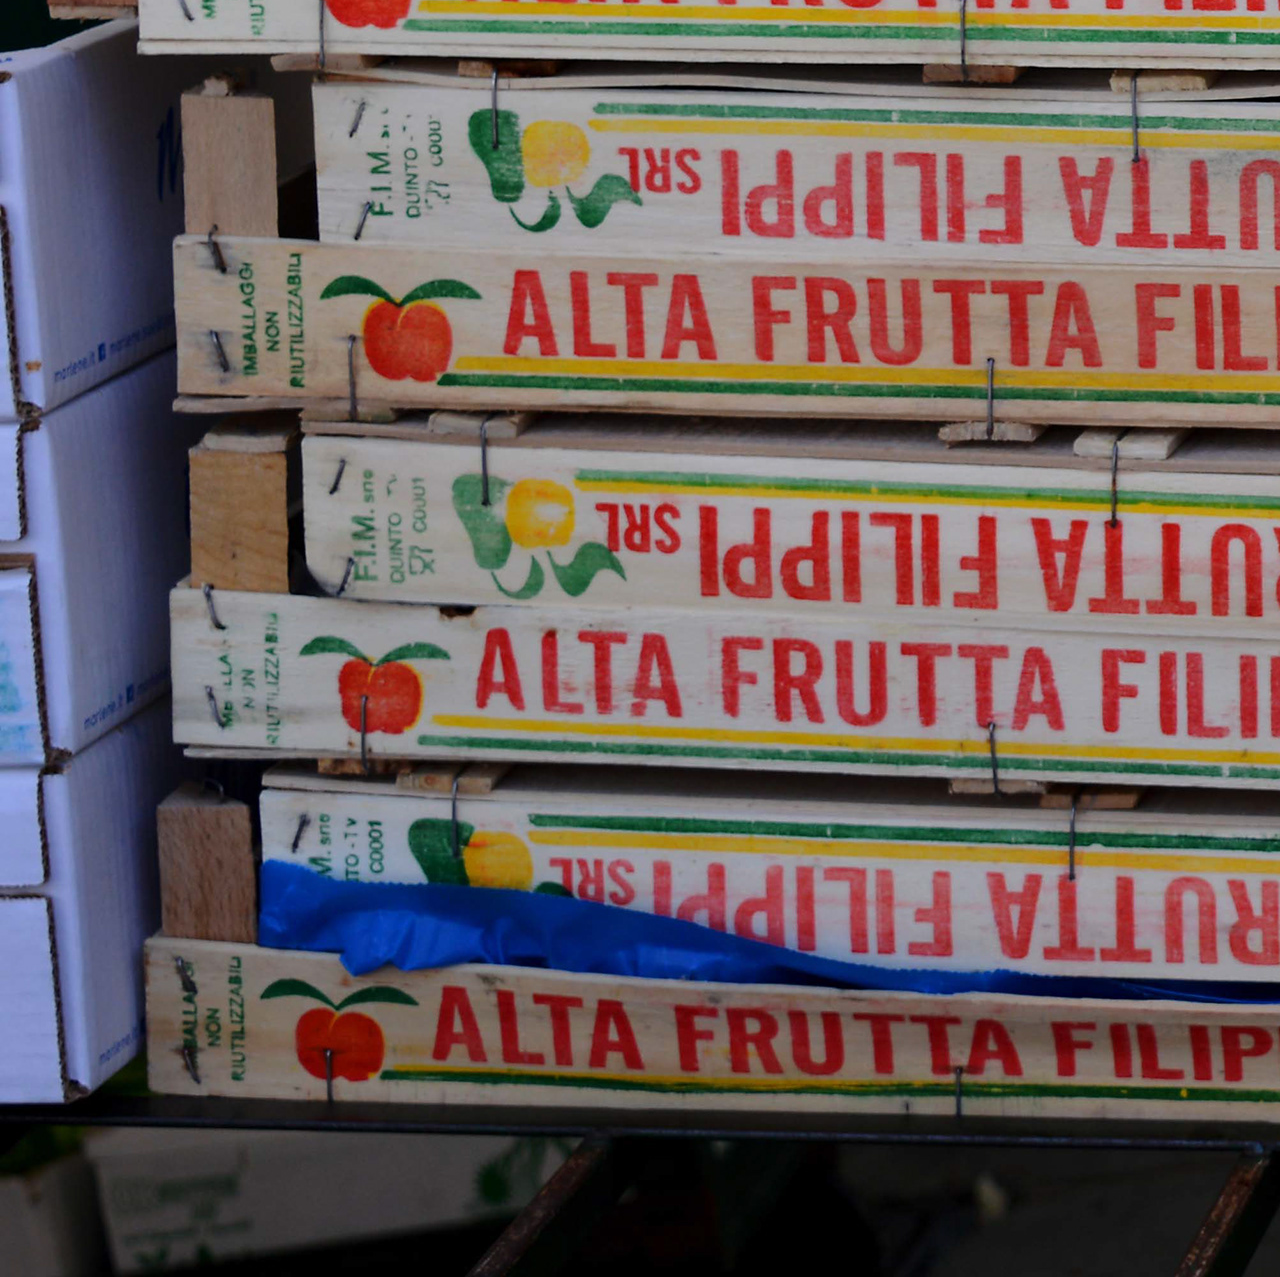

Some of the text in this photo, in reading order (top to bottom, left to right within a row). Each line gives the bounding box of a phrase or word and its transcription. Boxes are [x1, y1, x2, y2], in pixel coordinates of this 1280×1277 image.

[619, 147, 702, 194] SRL
[721, 149, 1024, 244] FILIPPI
[239, 262, 258, 377] IMBALLAGGI
[266, 311, 281, 353] NON
[287, 253, 305, 390] RIUTILIZZABILI
[503, 269, 718, 361] ALTA
[752, 276, 1103, 368] FRUTTA
[387, 512, 405, 584] QUINTO
[595, 502, 681, 554] SRL
[699, 504, 999, 609] FILIPPI
[476, 628, 682, 718] ALTA
[722, 637, 1064, 730] FRUTTA
[550, 858, 636, 905] SRL
[206, 1007, 221, 1048] NON
[431, 985, 646, 1071] ALTA
[672, 1004, 1023, 1077] FRUTTA
